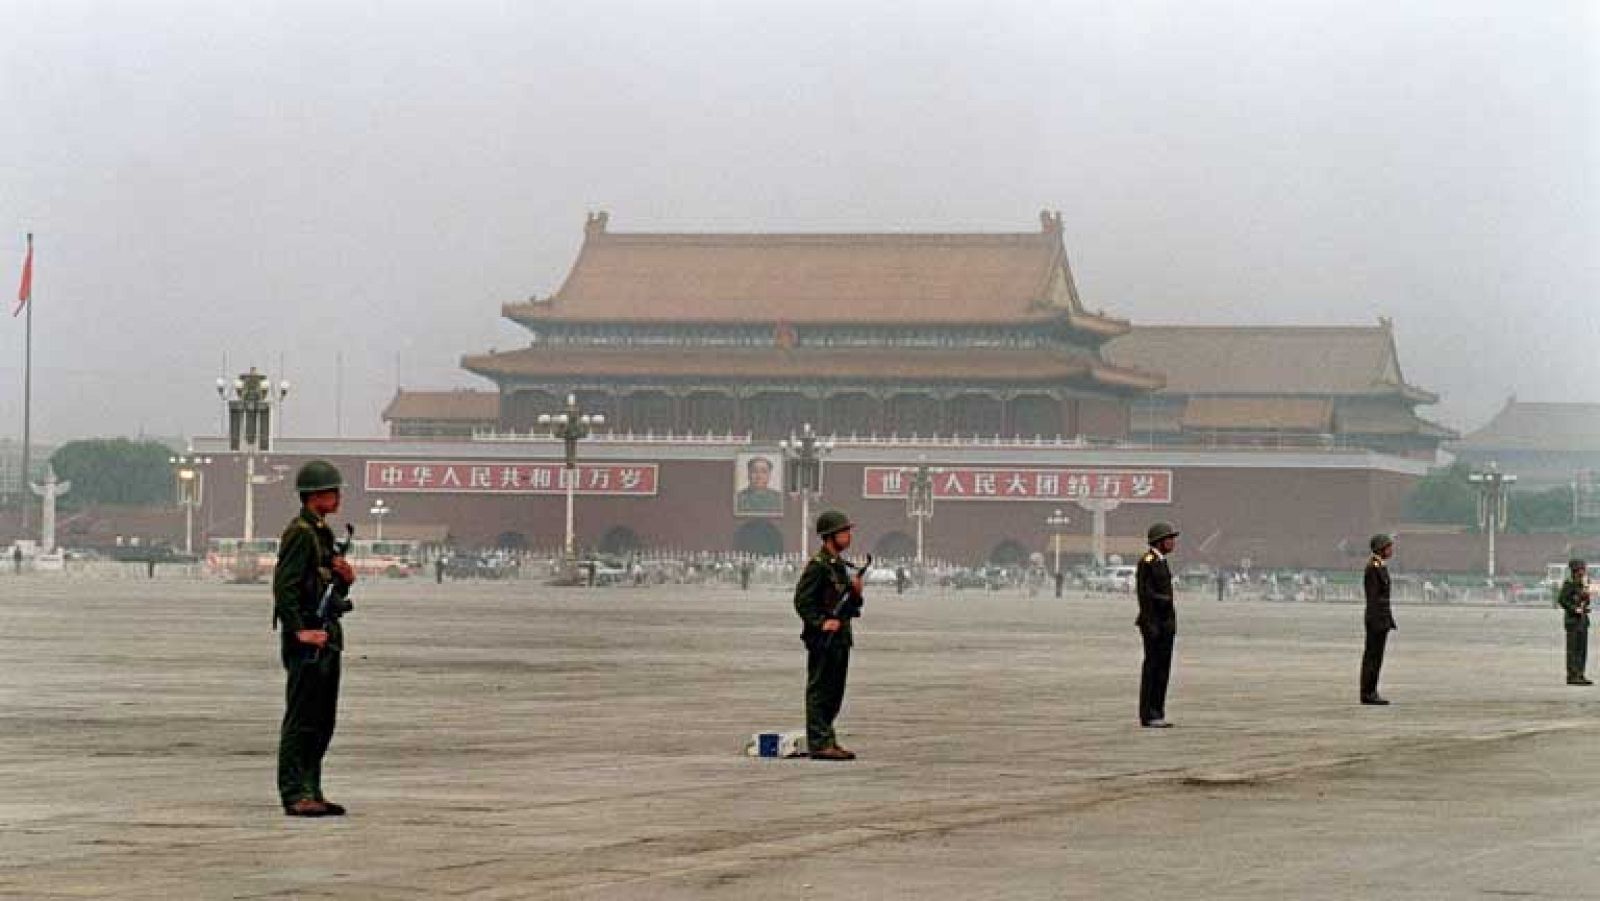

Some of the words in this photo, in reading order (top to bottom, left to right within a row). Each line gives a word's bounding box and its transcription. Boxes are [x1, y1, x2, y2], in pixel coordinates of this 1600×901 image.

[881, 470, 1154, 496] 世人民大团结万岁
